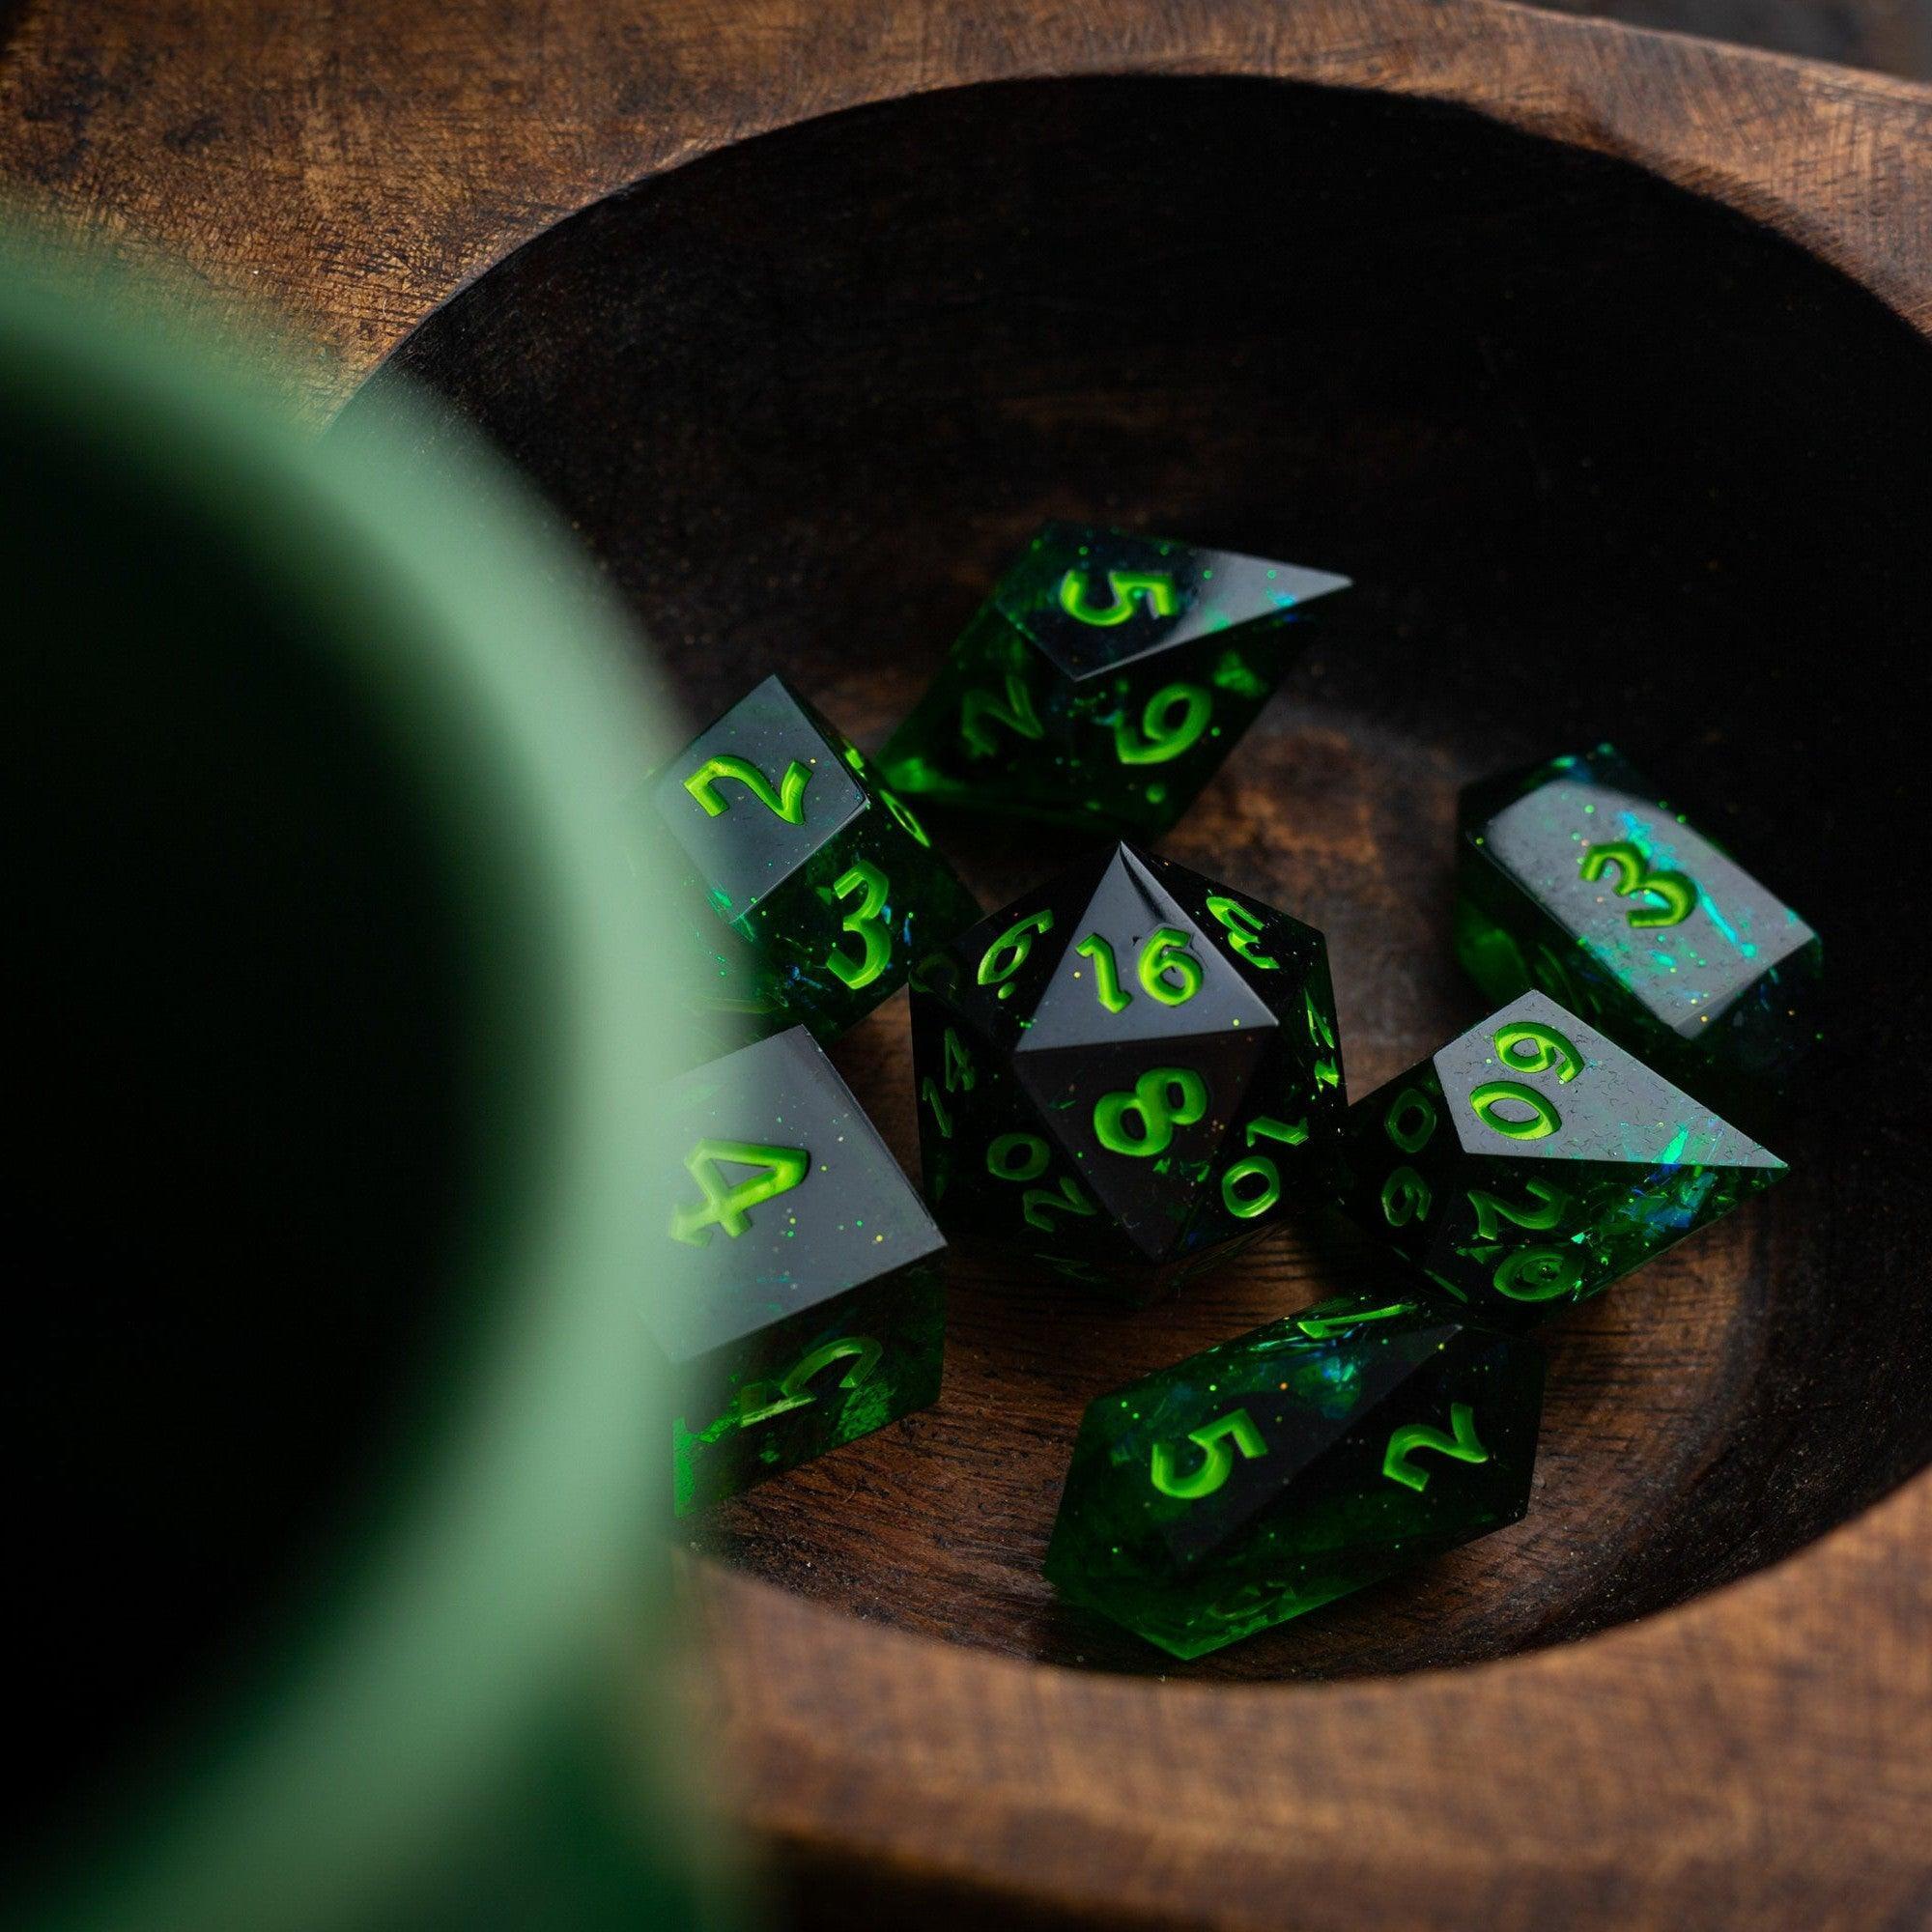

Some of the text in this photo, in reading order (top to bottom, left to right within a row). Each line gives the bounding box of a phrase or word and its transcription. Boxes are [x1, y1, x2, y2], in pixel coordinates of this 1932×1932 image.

[1060, 569, 1176, 628] 5
[682, 753, 814, 826] 2
[825, 859, 893, 990] 3
[1580, 841, 1698, 929] 3
[1074, 926, 1205, 1014] 16
[1092, 1065, 1211, 1158] 8
[669, 1137, 811, 1248] 4
[1220, 1114, 1311, 1220] 10
[1150, 1406, 1269, 1500] 5
[1381, 1400, 1490, 1493] 2
